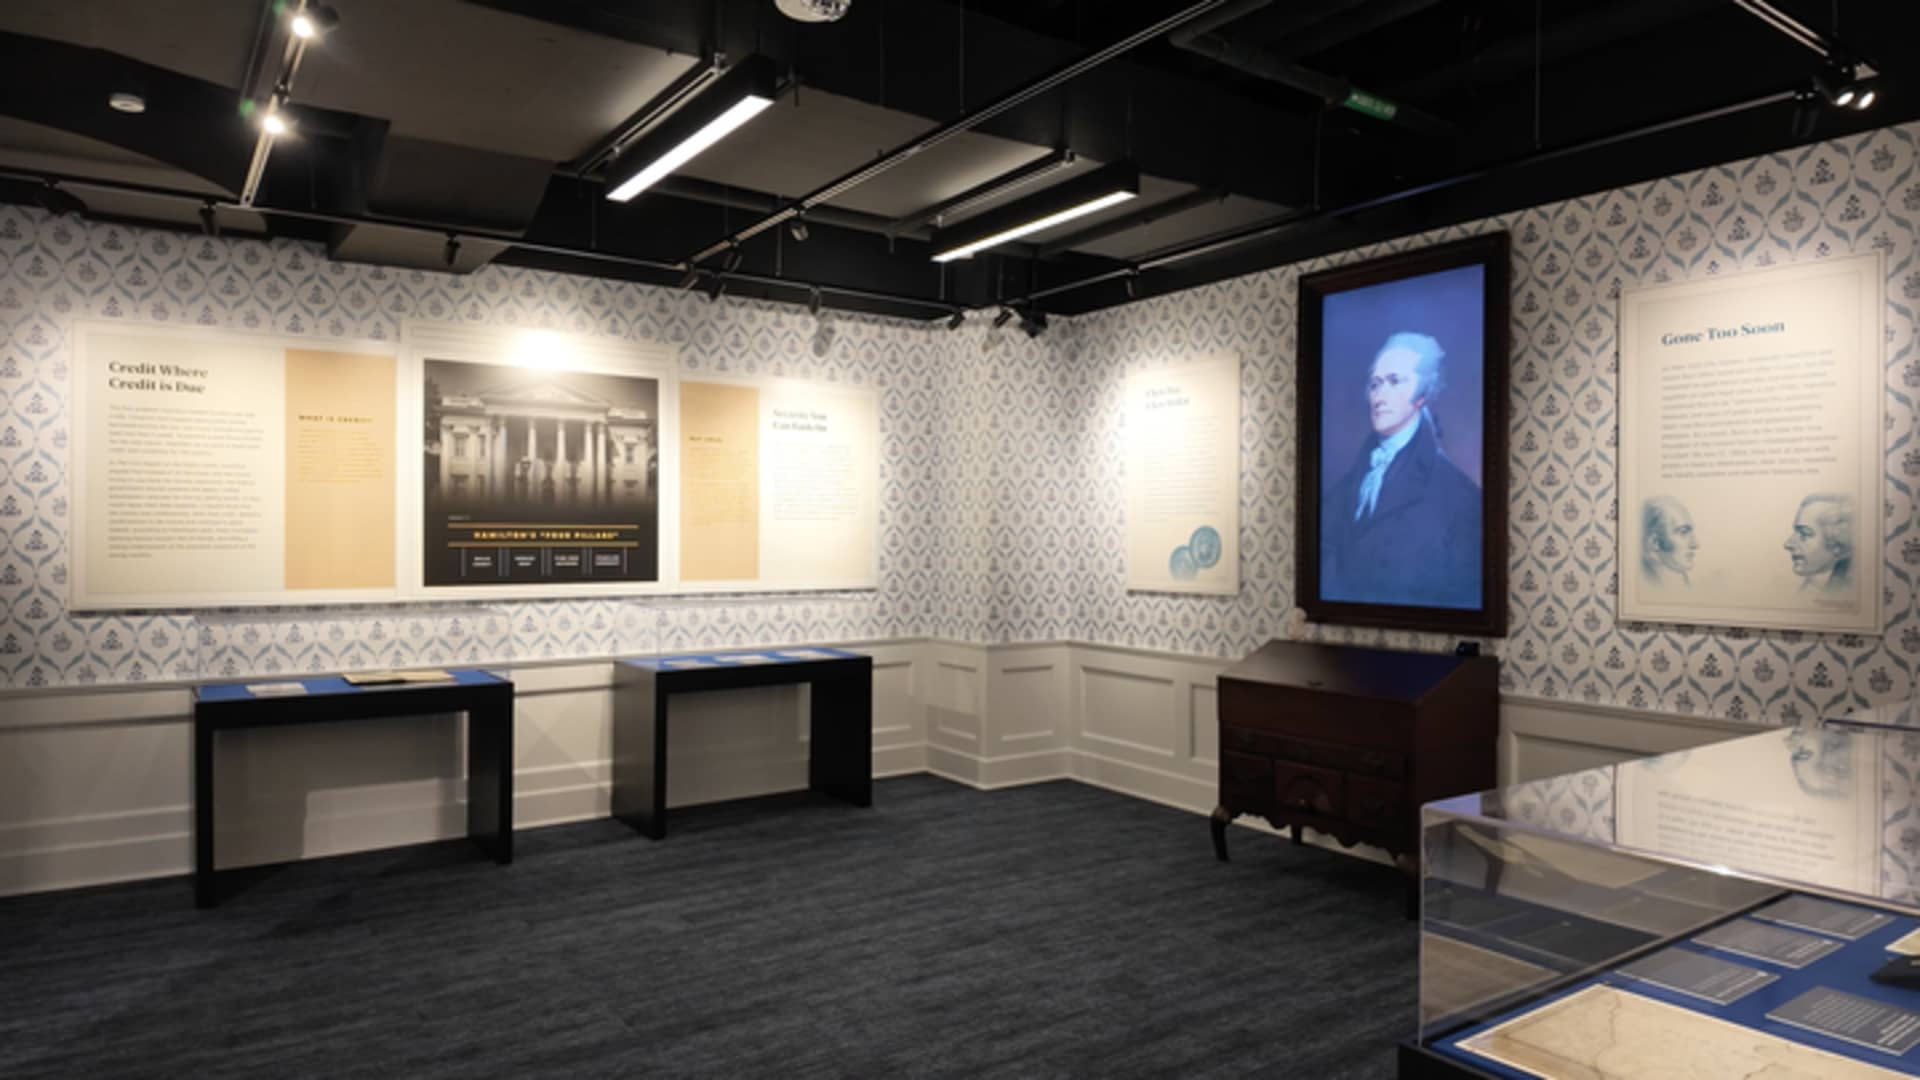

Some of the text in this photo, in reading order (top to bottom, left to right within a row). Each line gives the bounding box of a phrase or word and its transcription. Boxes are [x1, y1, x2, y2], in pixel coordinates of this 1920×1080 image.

[1661, 322, 1785, 345] Gone Too Soon
[108, 362, 208, 377] Credit Where
[108, 379, 206, 395] Credit is Due
